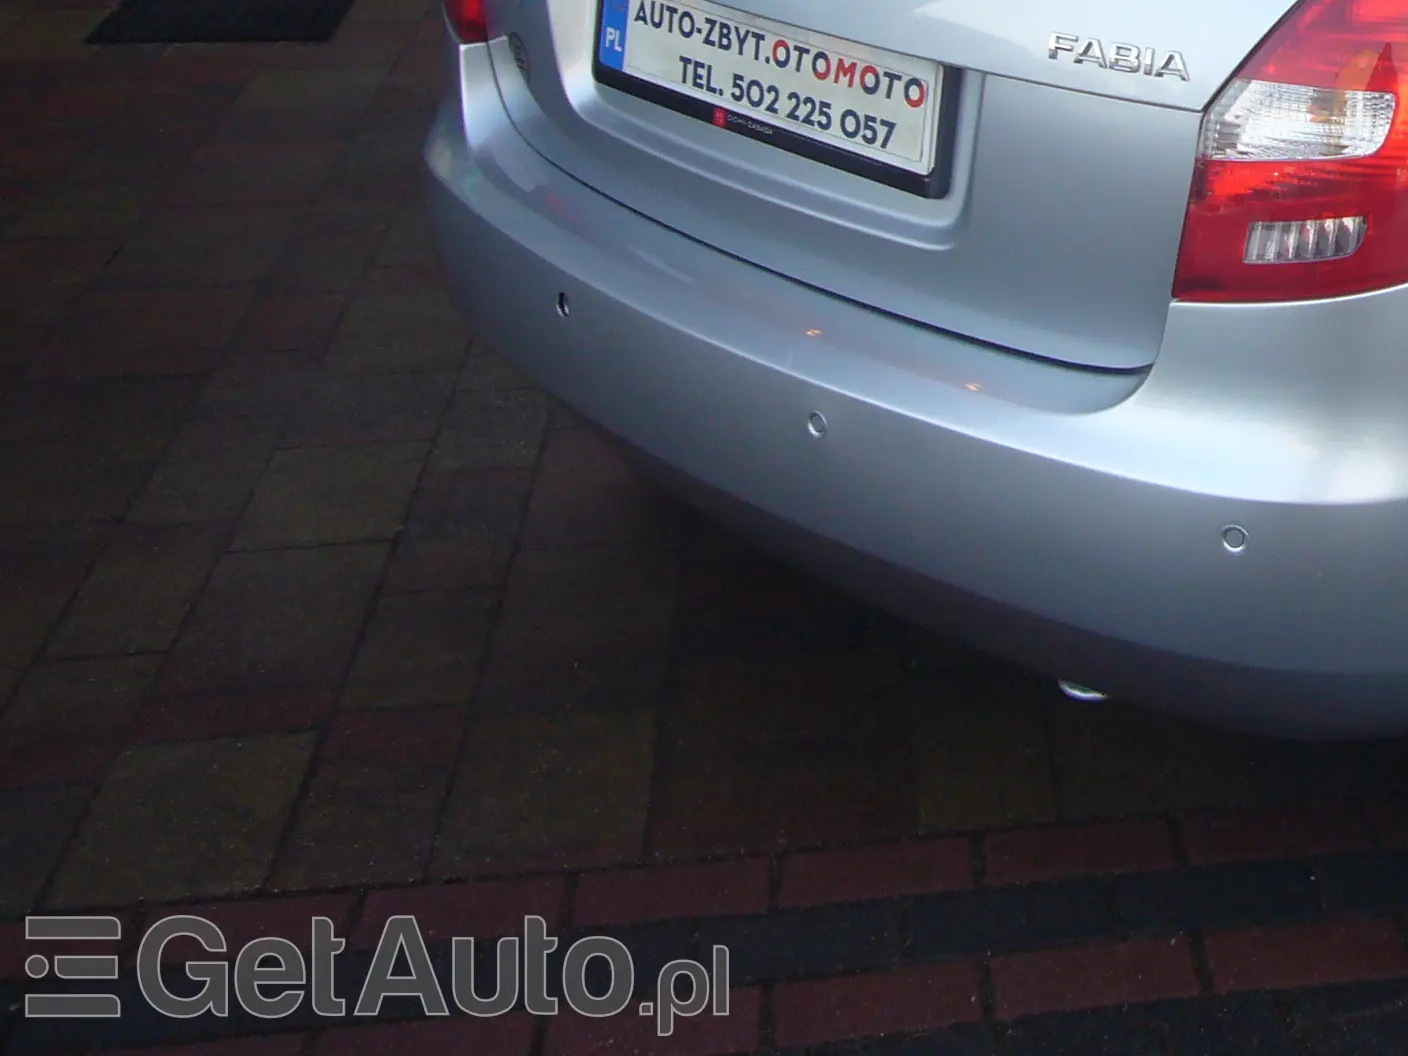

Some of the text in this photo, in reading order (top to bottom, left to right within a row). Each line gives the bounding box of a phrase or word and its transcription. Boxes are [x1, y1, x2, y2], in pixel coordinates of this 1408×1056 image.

[605, 27, 623, 52] PL
[1048, 32, 1190, 82] FABIA
[679, 55, 724, 96] TEL.
[731, 72, 780, 115] 502
[786, 91, 832, 130] 225
[840, 108, 897, 149] 057
